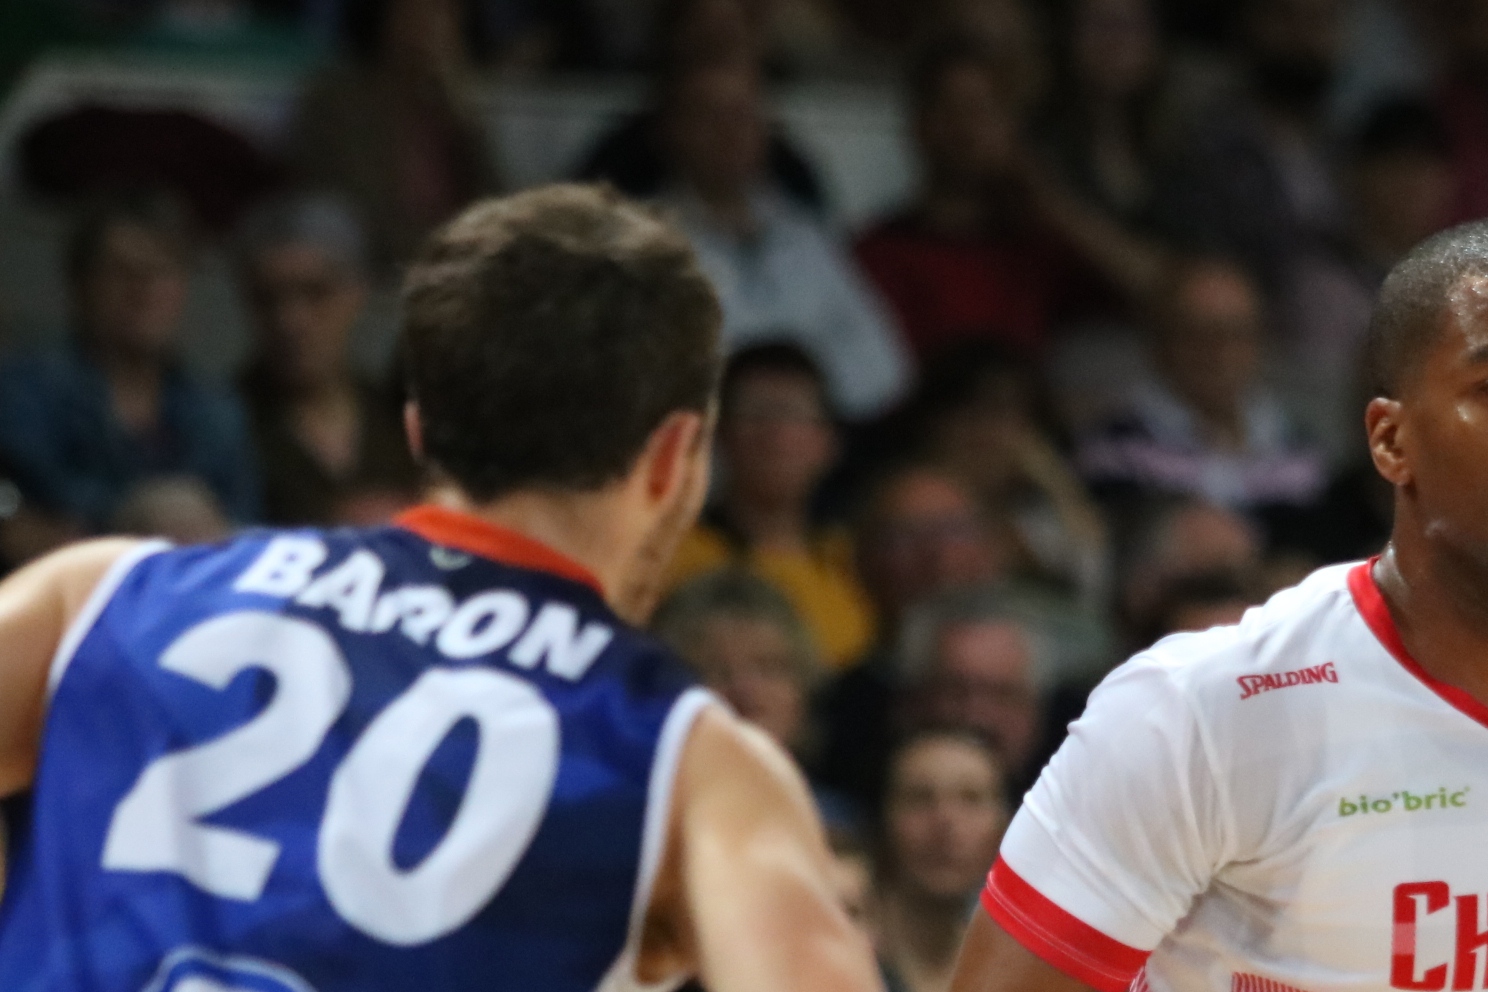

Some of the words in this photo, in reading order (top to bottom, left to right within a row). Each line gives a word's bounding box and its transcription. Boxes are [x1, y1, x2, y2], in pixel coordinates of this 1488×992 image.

[234, 534, 615, 682] BARON
[1236, 661, 1339, 700] SPALDING
[102, 610, 561, 946] 20
